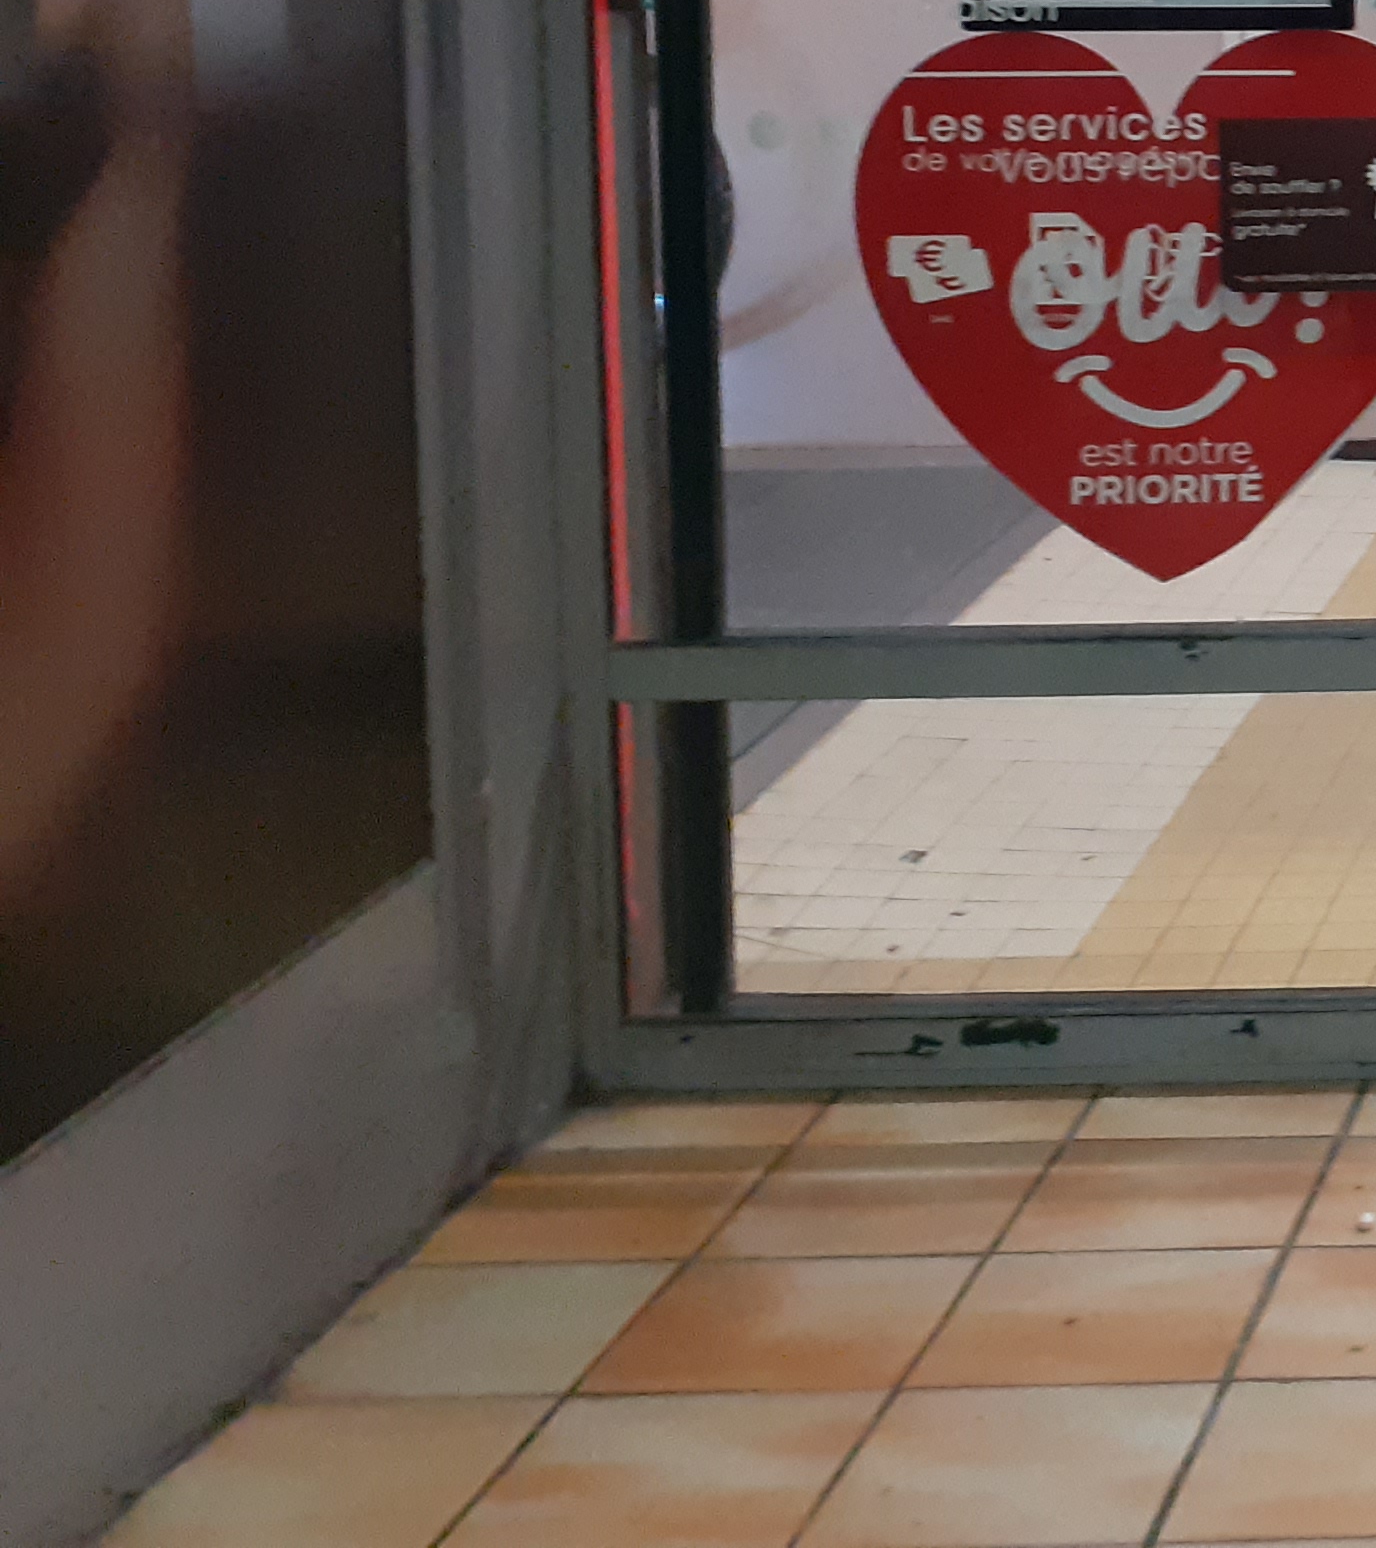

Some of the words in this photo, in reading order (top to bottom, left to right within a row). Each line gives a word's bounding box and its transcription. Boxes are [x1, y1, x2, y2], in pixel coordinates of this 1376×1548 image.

[902, 105, 985, 143] Les
[1002, 105, 1209, 142] services
[1078, 438, 1139, 468] est
[1148, 436, 1254, 466] notre
[1069, 464, 1265, 505] PRIORITÉ
